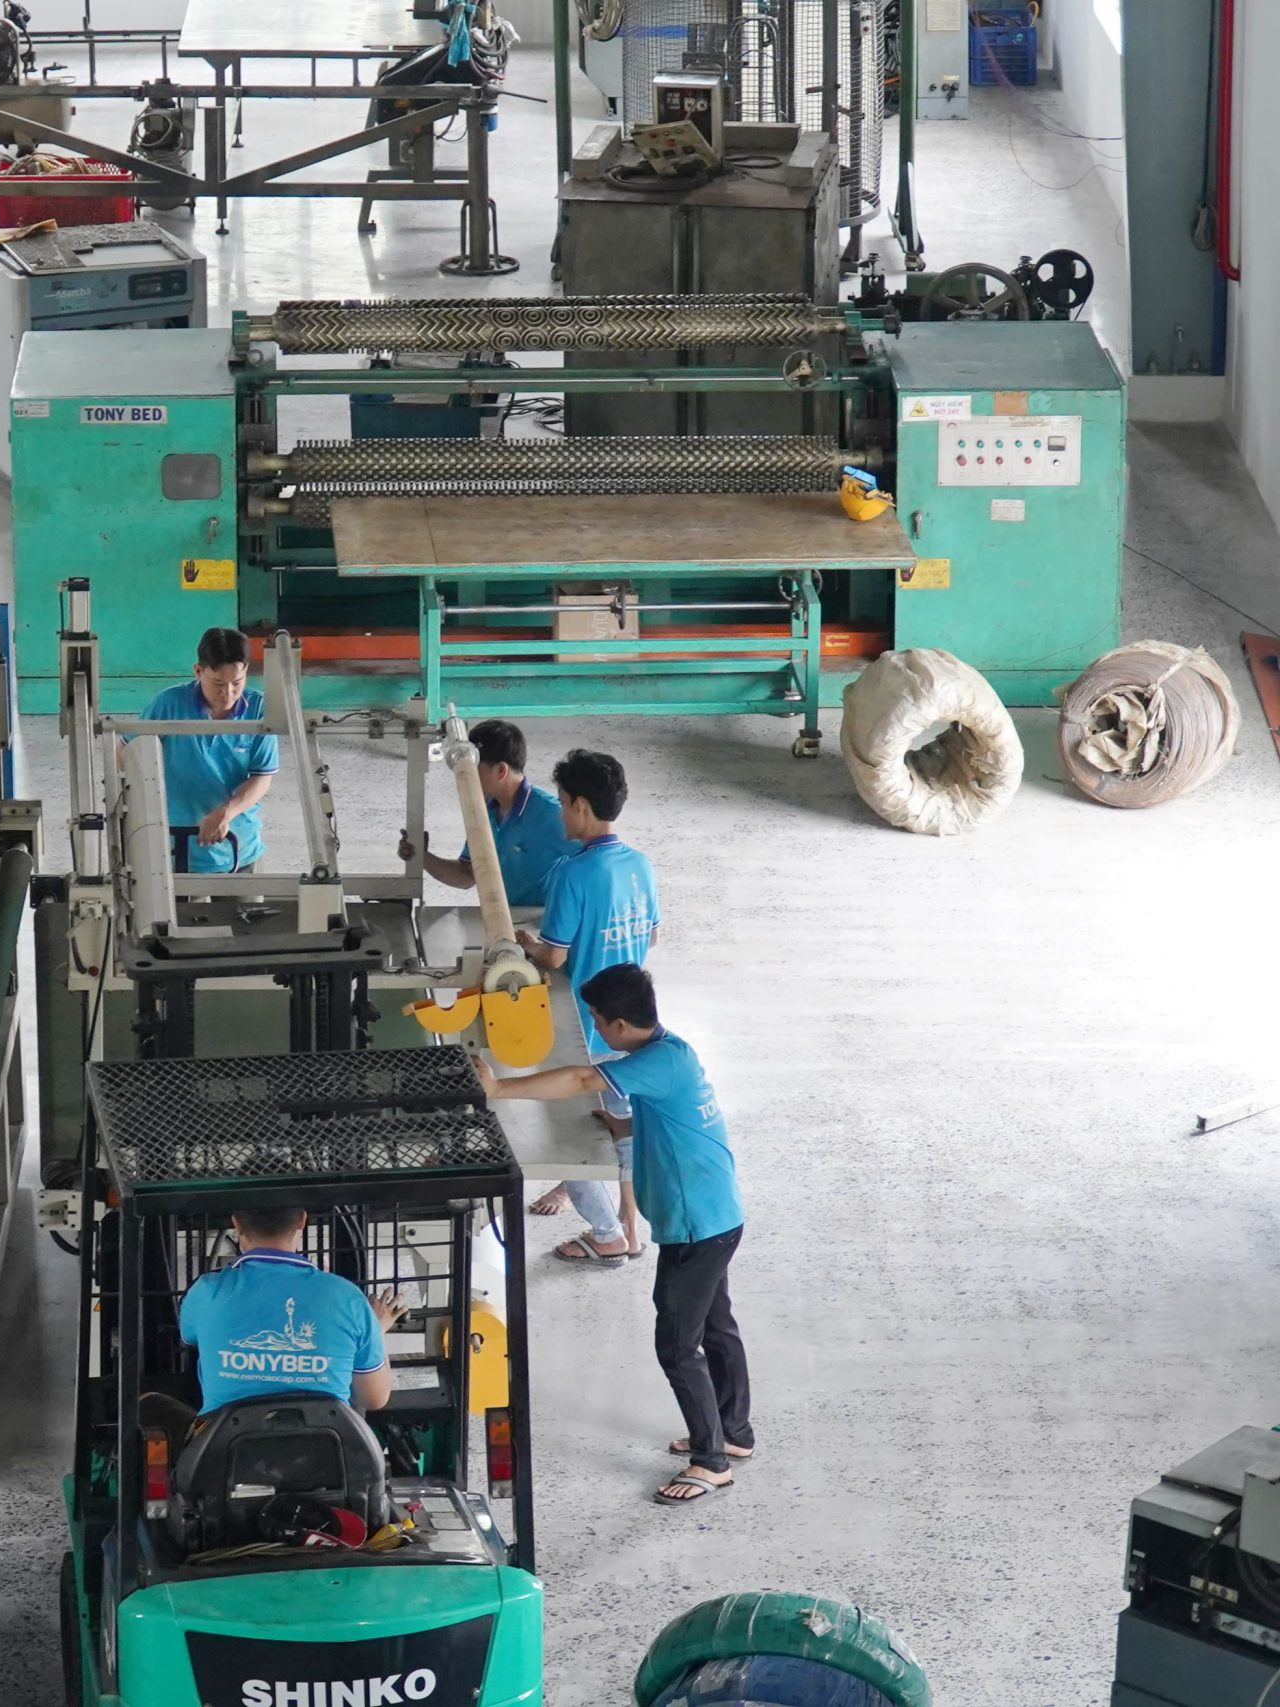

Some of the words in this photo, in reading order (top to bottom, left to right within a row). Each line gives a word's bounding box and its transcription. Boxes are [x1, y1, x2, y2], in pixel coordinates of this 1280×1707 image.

[84, 408, 125, 421] TONY
[131, 408, 162, 421] BED
[218, 1350, 328, 1373] TONYBED
[242, 1668, 436, 1707] SHINKO
